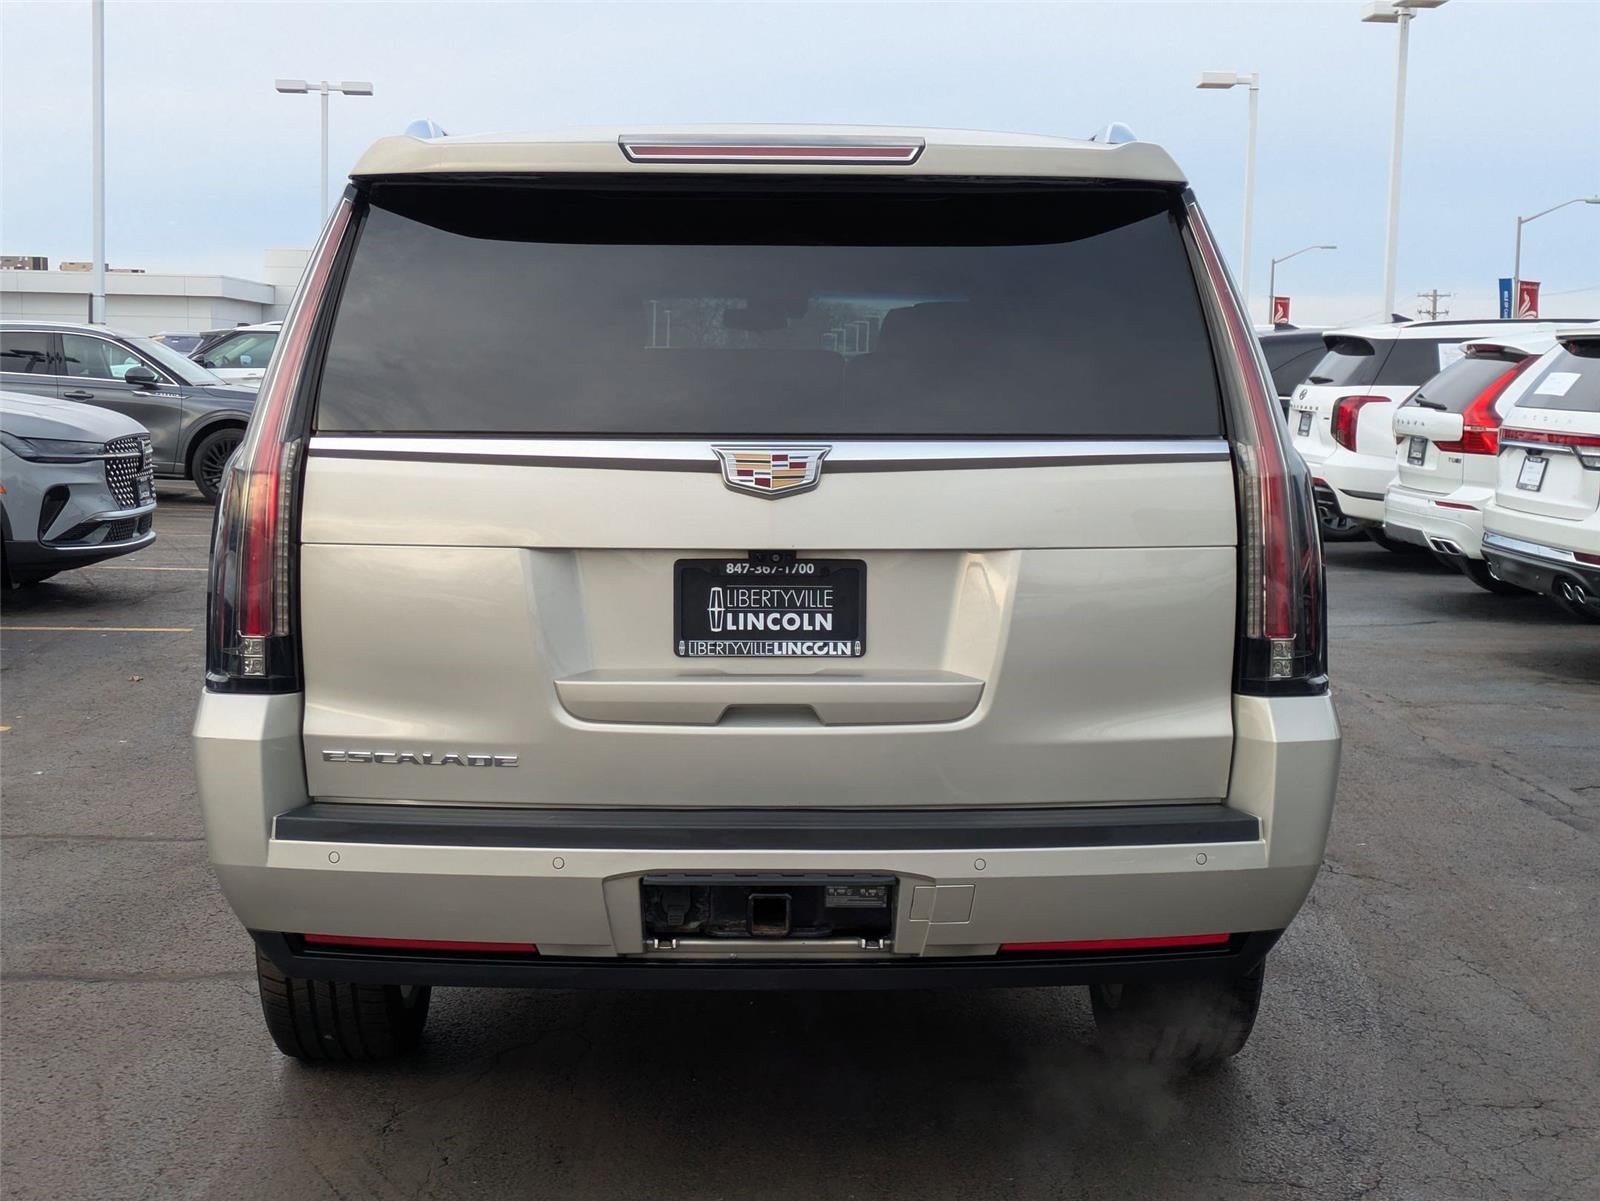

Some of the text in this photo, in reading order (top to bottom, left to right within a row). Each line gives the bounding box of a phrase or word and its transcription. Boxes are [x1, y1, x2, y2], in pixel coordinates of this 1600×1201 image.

[726, 589, 833, 608] LIBERTYVILLE
[726, 612, 833, 631] LINCOLN
[322, 750, 519, 767] ESCALADE
